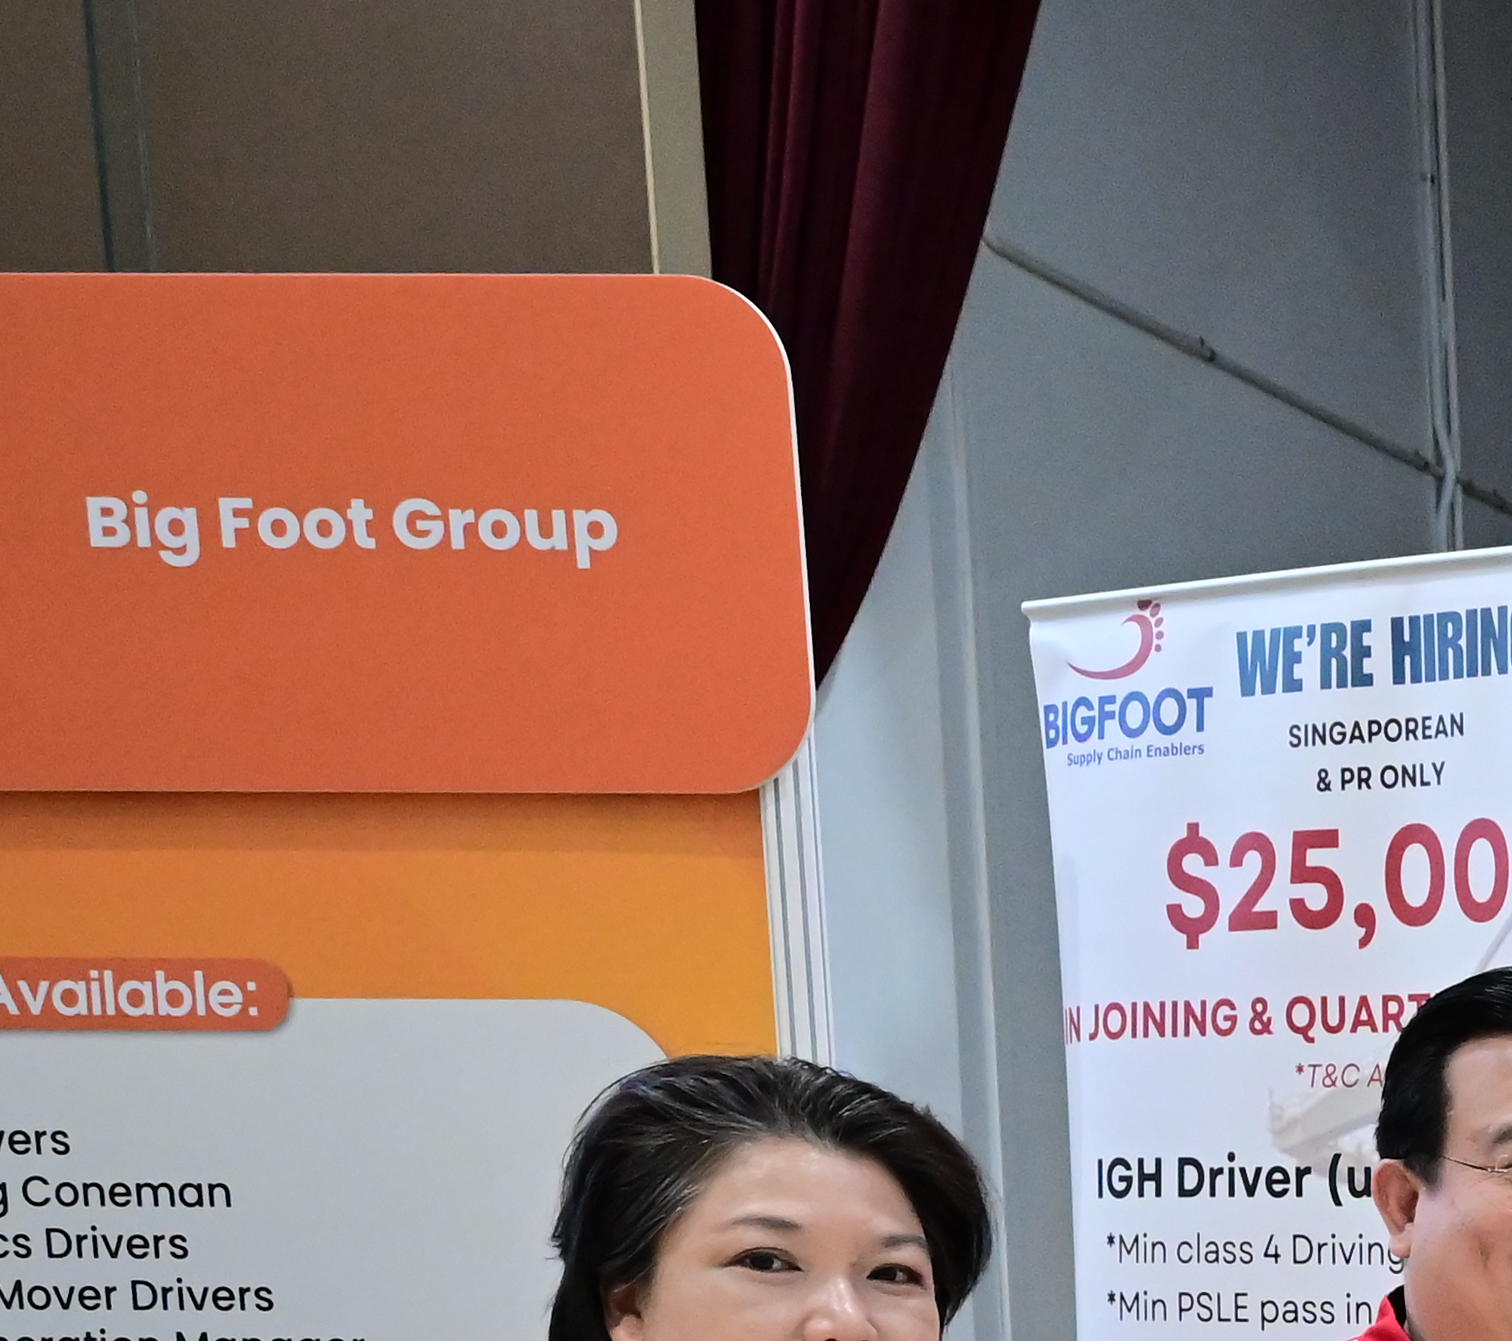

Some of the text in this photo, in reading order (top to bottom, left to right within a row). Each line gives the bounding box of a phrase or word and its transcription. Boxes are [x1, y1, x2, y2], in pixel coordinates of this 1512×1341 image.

[86, 493, 619, 569] Big Foot Group
[1042, 685, 1214, 749] BIGFOOT
[1288, 712, 1465, 748] SINGAPOREAN
[1067, 742, 1205, 768] Supply Chain Enablers
[1316, 761, 1446, 792] & PR ONLY
[1088, 998, 1238, 1042] JOINING
[1248, 996, 1274, 1035] &
[22, 1175, 232, 1208] Coneman
[1098, 1157, 1162, 1199] IGH
[1177, 1151, 1312, 1198] Driver
[45, 1225, 189, 1260] Drivers
[1176, 1232, 1253, 1264] class
[1263, 1235, 1281, 1264] 4
[131, 1277, 275, 1312] Drivers
[1178, 1292, 1249, 1323] PSLE
[1261, 1299, 1335, 1331] pass
[1346, 1293, 1372, 1325] in
